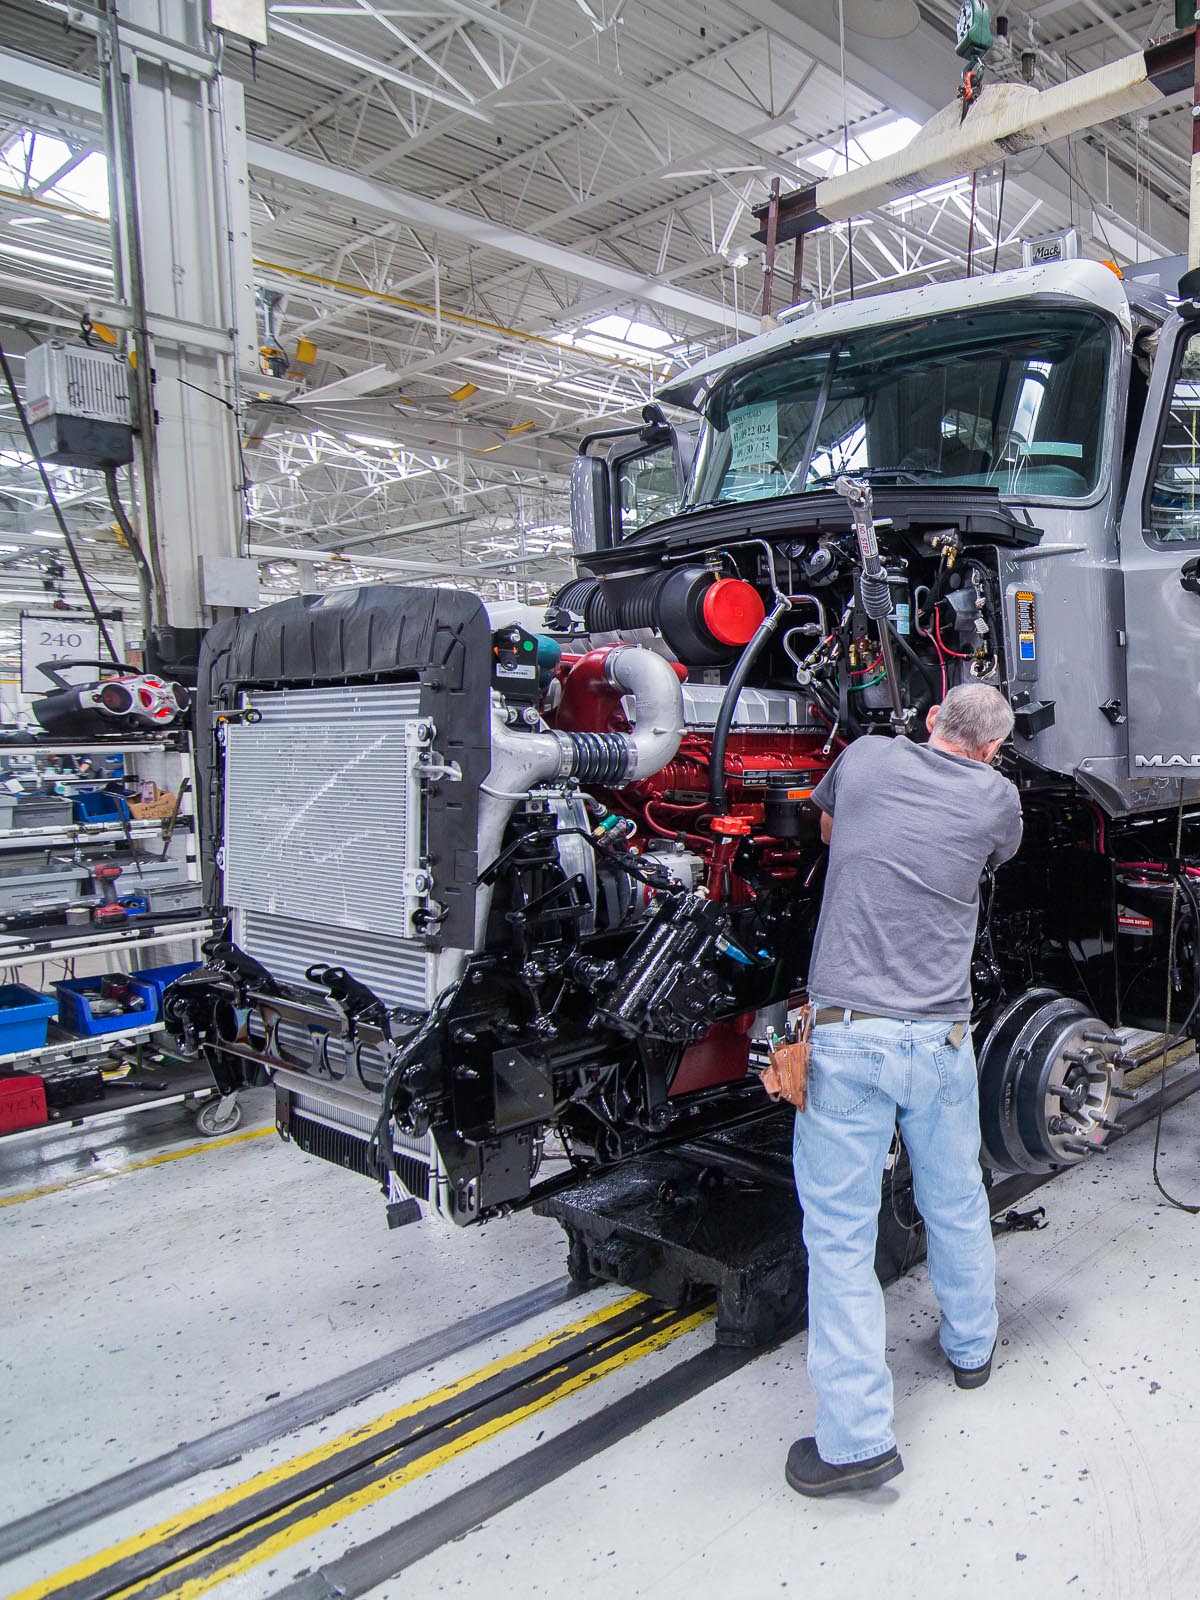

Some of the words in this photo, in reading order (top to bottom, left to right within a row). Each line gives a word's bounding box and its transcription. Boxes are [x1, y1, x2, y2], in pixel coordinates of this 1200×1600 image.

[1034, 244, 1061, 258] Mack
[858, 525, 866, 535] NO
[860, 537, 870, 555] STEP
[40, 631, 83, 648] 240
